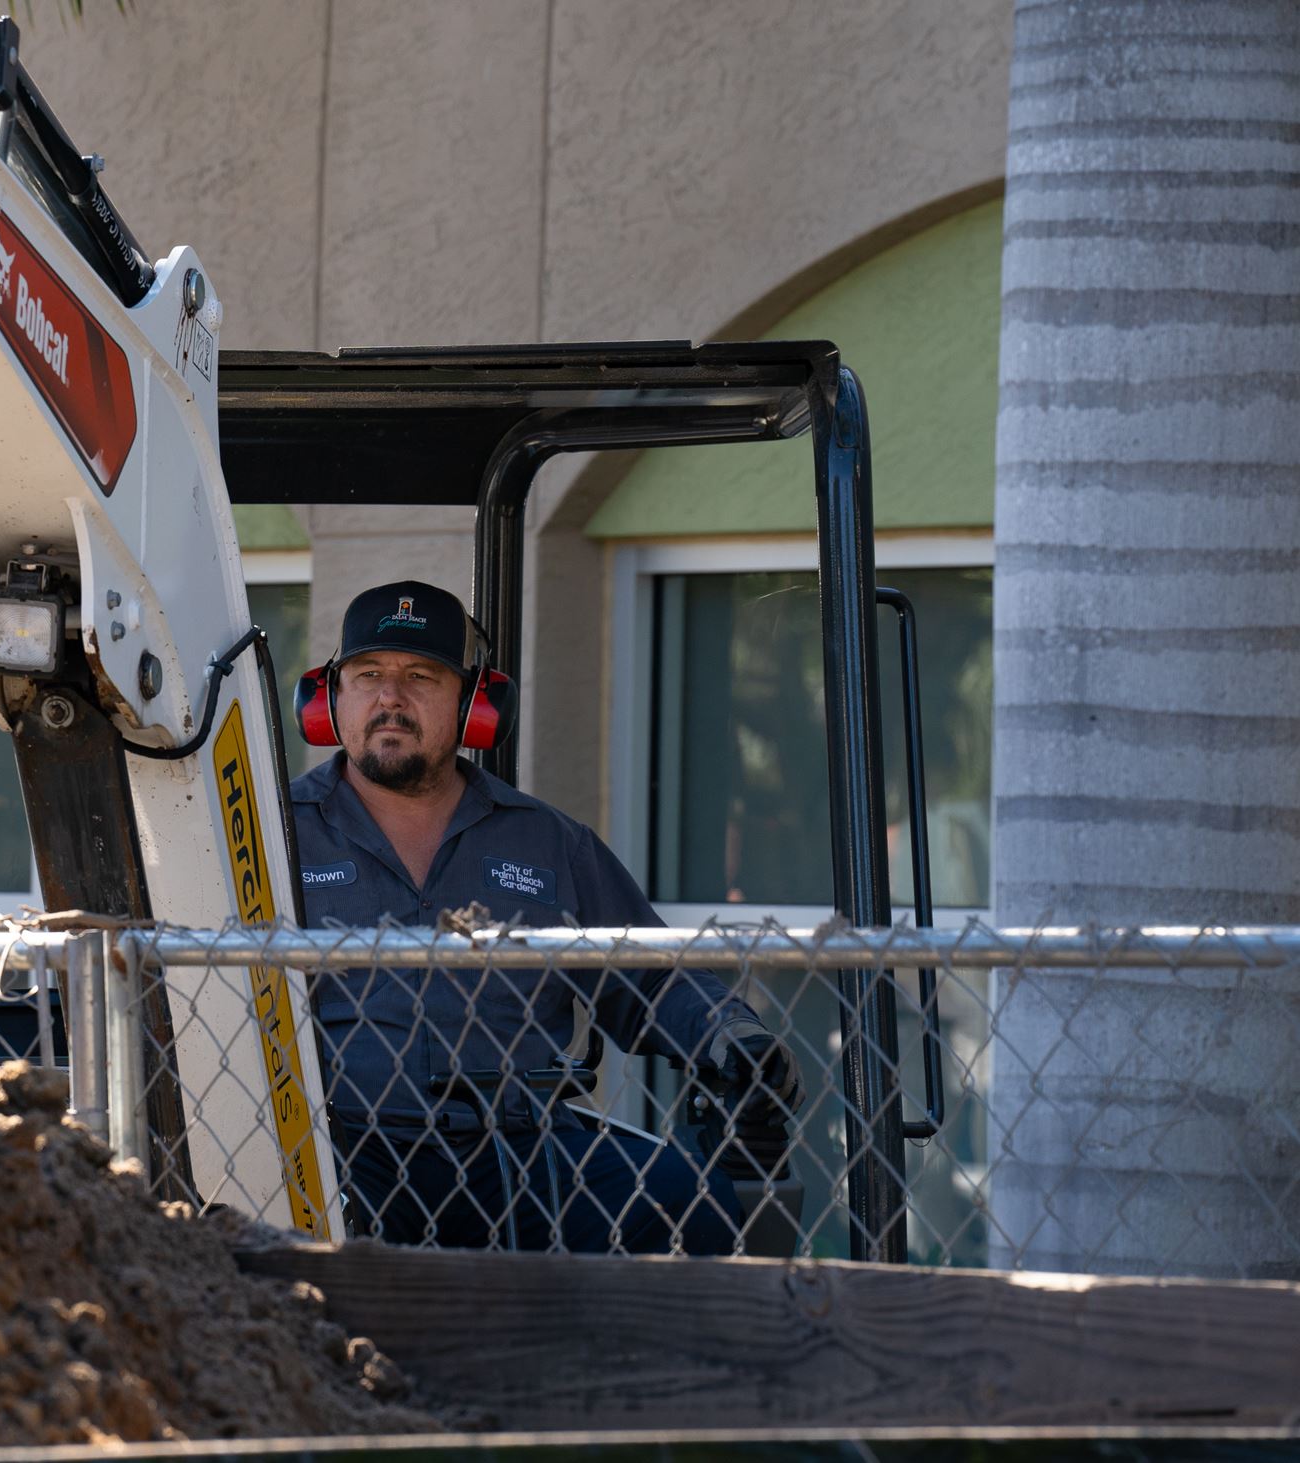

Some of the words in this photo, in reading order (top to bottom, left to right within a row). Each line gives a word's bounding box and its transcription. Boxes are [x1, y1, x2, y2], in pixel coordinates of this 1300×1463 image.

[15, 272, 69, 385] Bobcat
[302, 870, 345, 883] Shawn
[502, 862, 521, 875] City
[522, 868, 533, 877] of
[491, 868, 516, 881] Palm
[516, 873, 544, 889] Beach
[499, 878, 538, 895] Gardens
